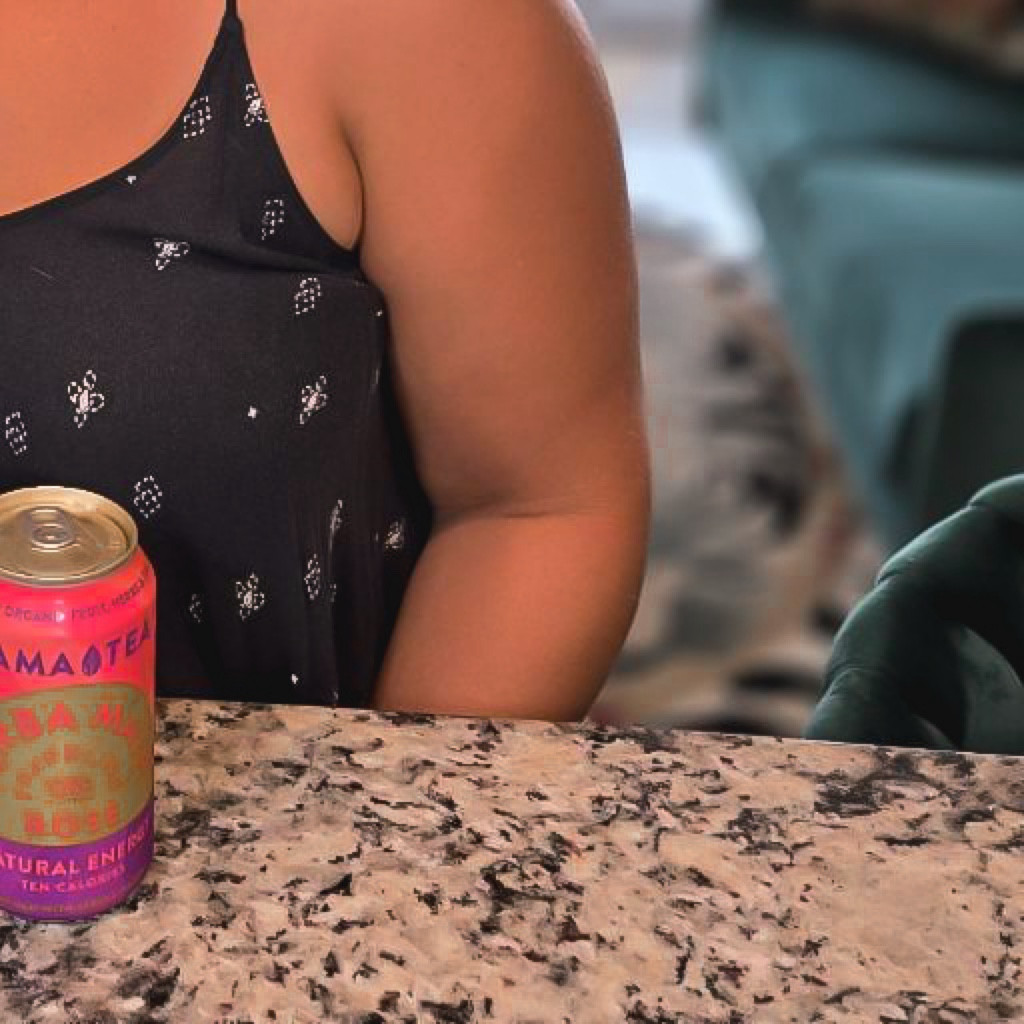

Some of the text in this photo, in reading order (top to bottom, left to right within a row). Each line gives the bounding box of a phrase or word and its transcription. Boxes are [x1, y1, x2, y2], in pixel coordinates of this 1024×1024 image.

[4, 605, 67, 624] ORGANI
[106, 617, 152, 667] TEA
[87, 817, 152, 872] ENERG
[21, 864, 126, 894] TEN CALORIES
